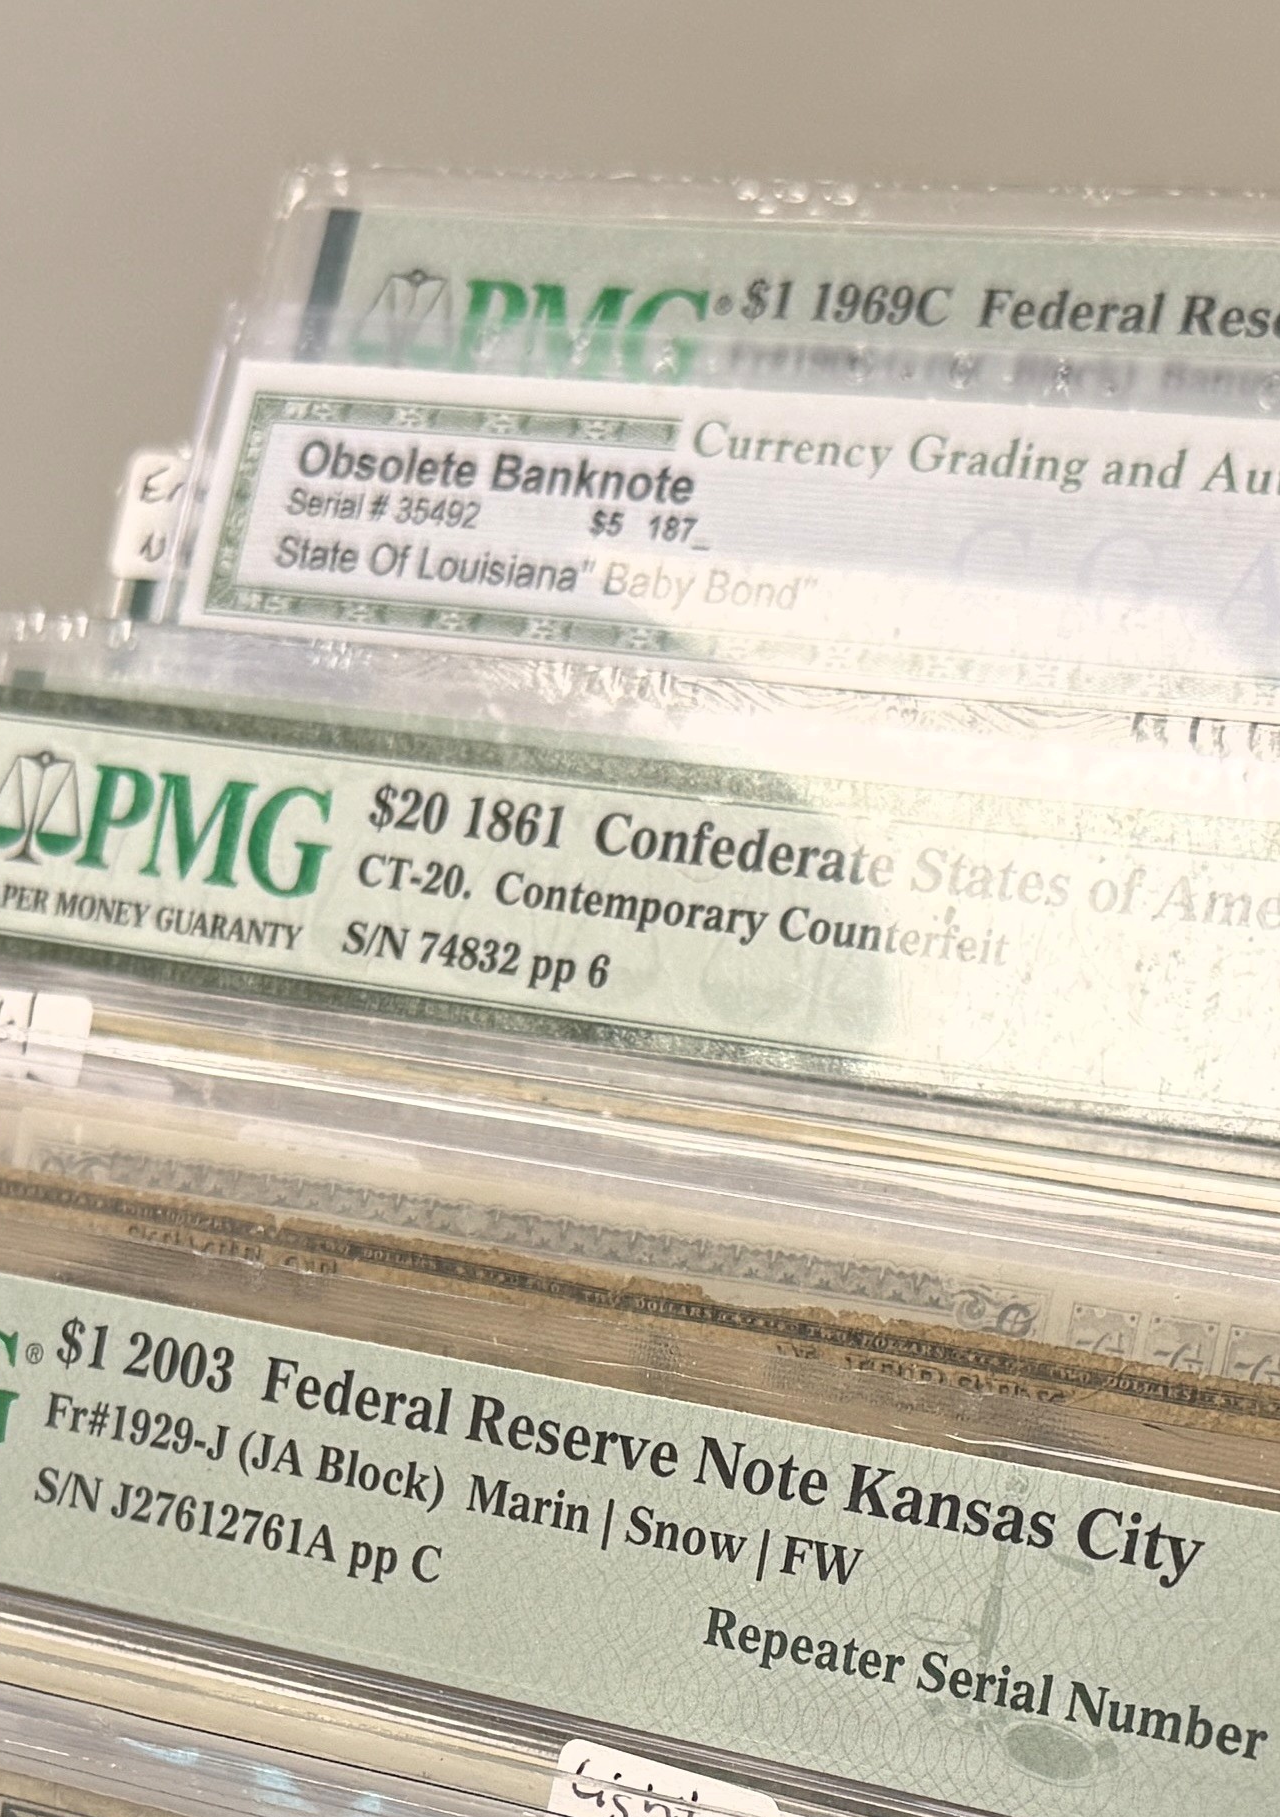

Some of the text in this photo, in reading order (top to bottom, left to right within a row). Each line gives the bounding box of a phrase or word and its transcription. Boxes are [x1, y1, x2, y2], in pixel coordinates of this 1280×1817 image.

[741, 279, 789, 321] $1
[809, 283, 953, 328] 1969C
[977, 288, 1165, 335] Federal
[298, 439, 696, 504] Obsolete Banknote
[693, 422, 893, 479] Currency
[909, 434, 1088, 493] Grading
[1103, 450, 1188, 490] and
[287, 487, 482, 530] Serial # 35492
[590, 509, 625, 538] $5
[274, 535, 359, 574] State
[368, 542, 410, 579] Of
[603, 562, 695, 610] Baby
[75, 763, 333, 900] PMG
[368, 783, 449, 836] $20
[461, 795, 566, 850] 1861
[595, 812, 893, 889] Confederate
[909, 846, 1070, 907] States
[1088, 867, 1148, 917] of
[55, 889, 151, 929] MONEY
[154, 905, 305, 951] GUARANTY
[358, 853, 1010, 968] CT-20. Contemporary Counterfeit
[341, 918, 611, 990] S/N 74832 pp 6
[43, 1392, 231, 1463] Fr#1929-J
[236, 1431, 305, 1479] (JA
[318, 1444, 446, 1513] Block)
[466, 1474, 593, 1537] Marin
[623, 1506, 750, 1567] Snow
[779, 1535, 865, 1588] FW
[56, 1316, 1206, 1590] $1 2003 Federal Reserve Note Kansas City
[33, 1465, 444, 1584] S/N J27612761A pp C
[702, 1606, 1271, 1762] Repeater Serial Number
